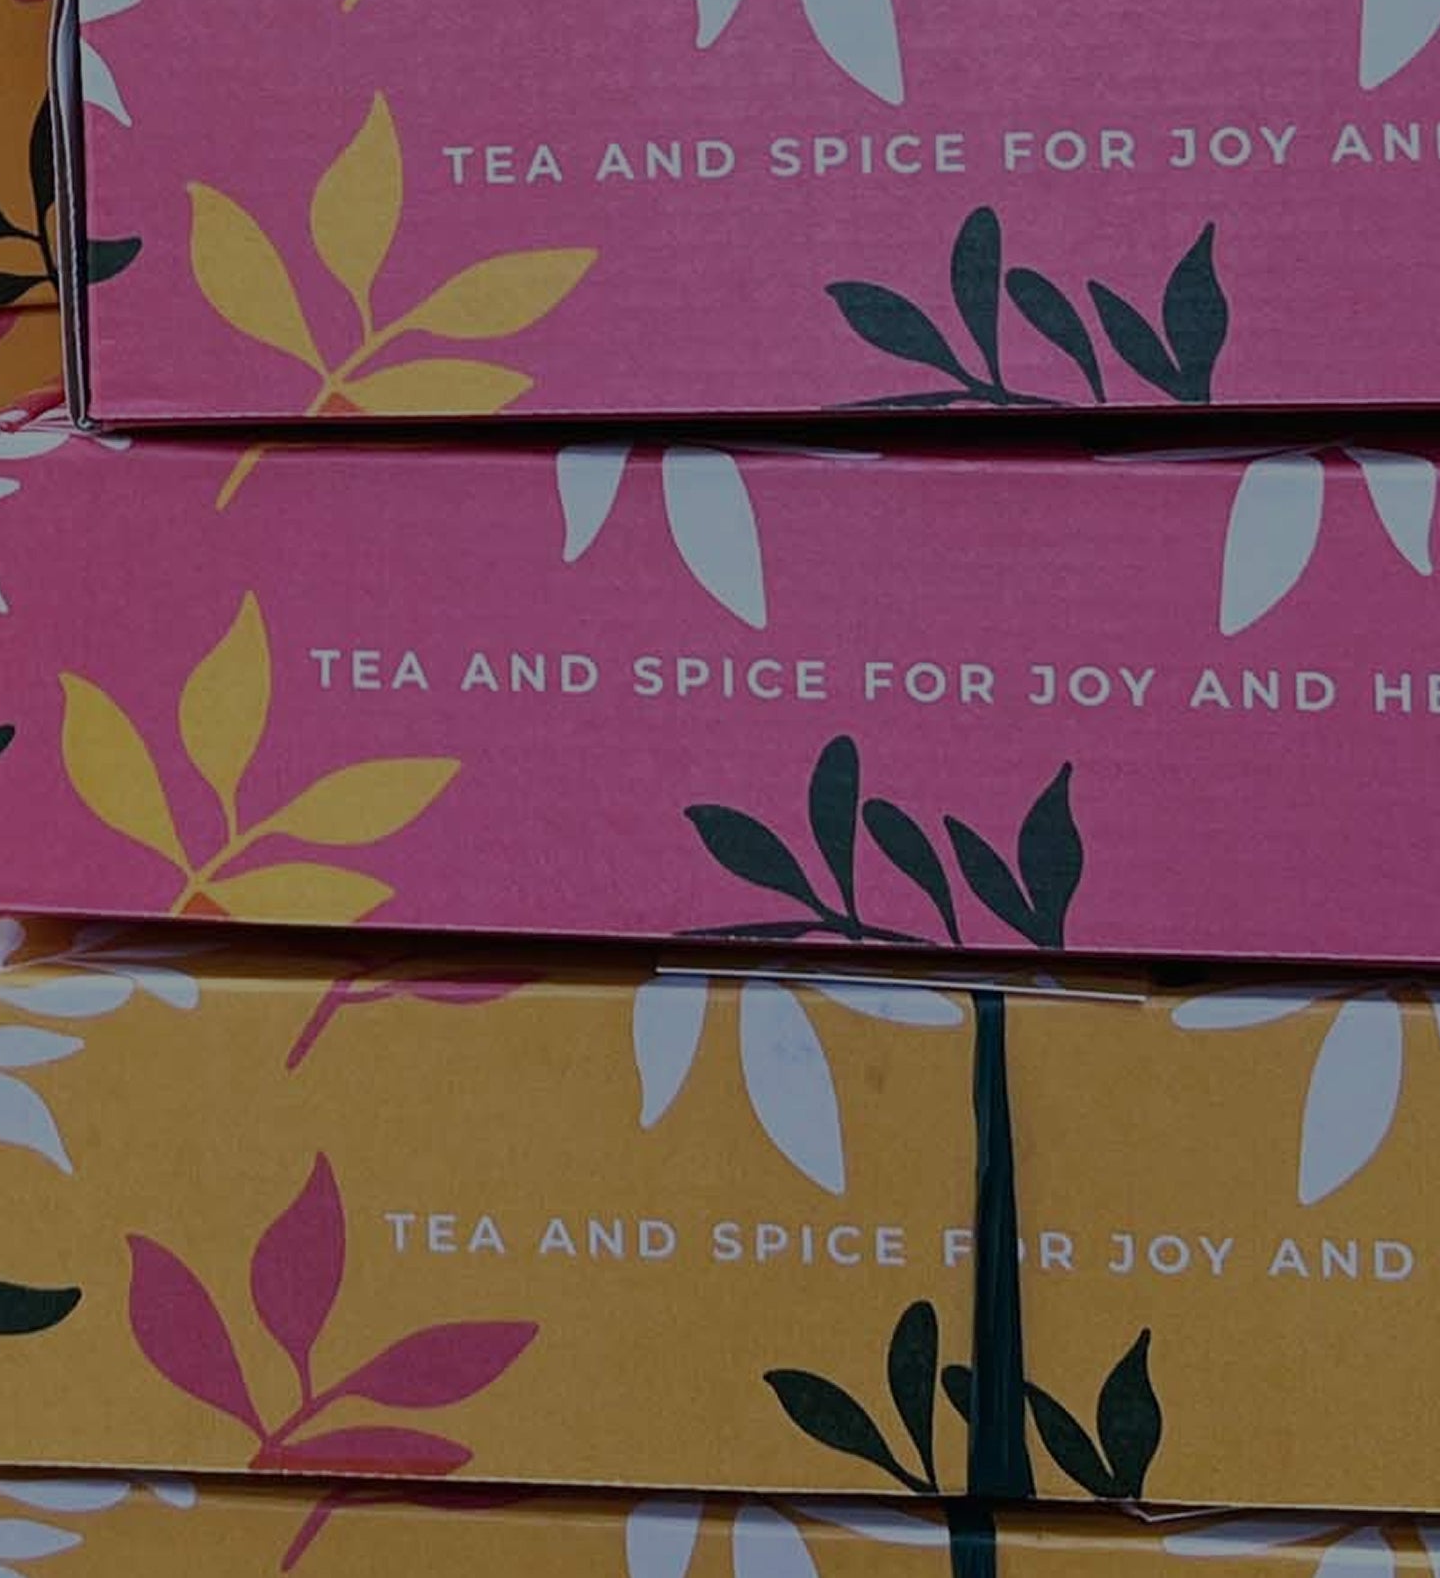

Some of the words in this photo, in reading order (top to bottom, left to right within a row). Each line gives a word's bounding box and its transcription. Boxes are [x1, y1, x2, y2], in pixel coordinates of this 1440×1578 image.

[441, 144, 564, 184] TEA
[595, 139, 736, 181] AND
[769, 133, 967, 178] SPICE
[1003, 129, 1135, 171] FOR
[1169, 125, 1298, 168] JOY
[309, 648, 429, 691] TEA
[460, 652, 599, 694] AND
[632, 655, 827, 700] SPICE
[864, 661, 995, 704] FOR
[1028, 664, 1155, 707] JOY
[1189, 668, 1336, 712] AND
[383, 1212, 506, 1256] TEA
[538, 1217, 677, 1260] AND
[712, 1221, 906, 1267] SPICE
[942, 1228, 1074, 1271] FR
[1108, 1233, 1234, 1276] JOY
[1267, 1237, 1415, 1283] AND
